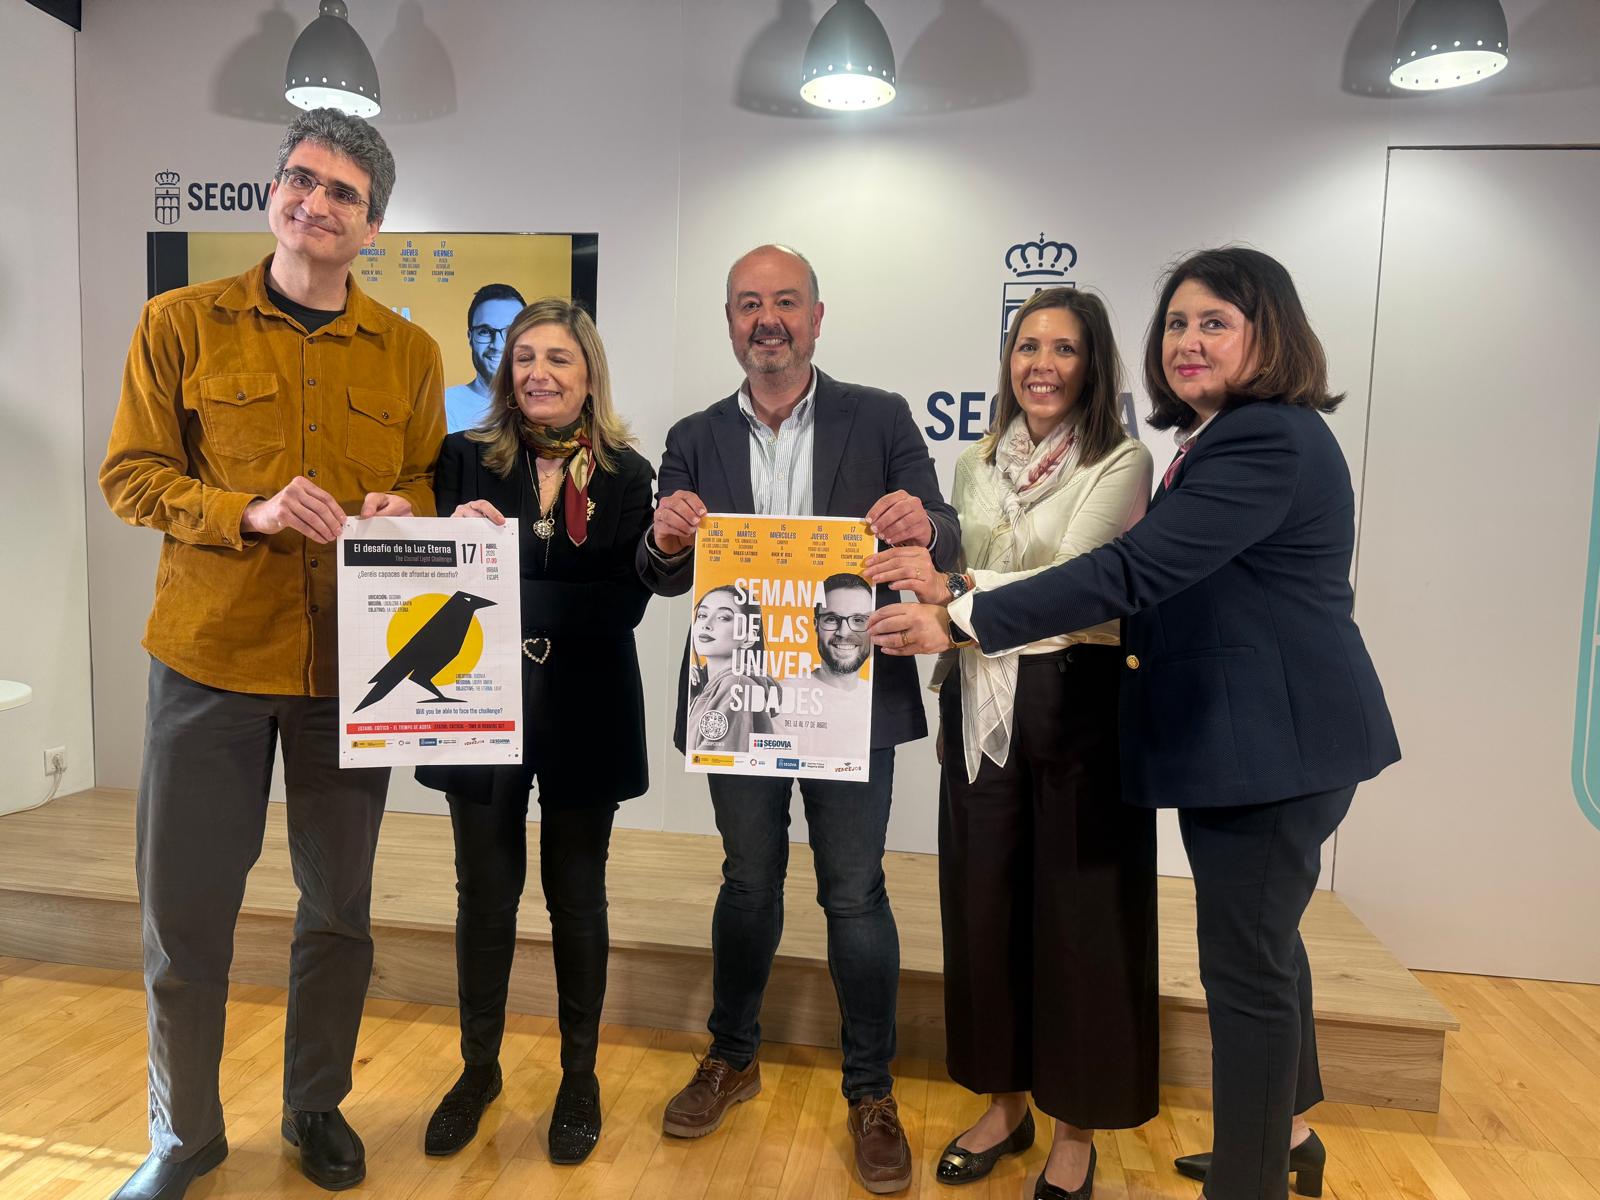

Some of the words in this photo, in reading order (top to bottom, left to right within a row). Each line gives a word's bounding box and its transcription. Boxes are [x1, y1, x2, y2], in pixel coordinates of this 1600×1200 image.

[187, 182, 271, 211] SEGOV
[353, 543, 361, 553] El
[362, 543, 392, 553] desafío
[393, 544, 403, 553] de
[404, 544, 412, 553] la
[414, 544, 426, 554] Luz
[427, 544, 452, 554] Eterna
[461, 544, 476, 564] 17
[734, 578, 827, 608] SEMANA
[733, 613, 761, 642] DE
[768, 614, 809, 644] LAS
[731, 649, 821, 680] UNIVER-
[729, 684, 824, 716] SIDADES
[764, 740, 792, 748] SEGOVIA
